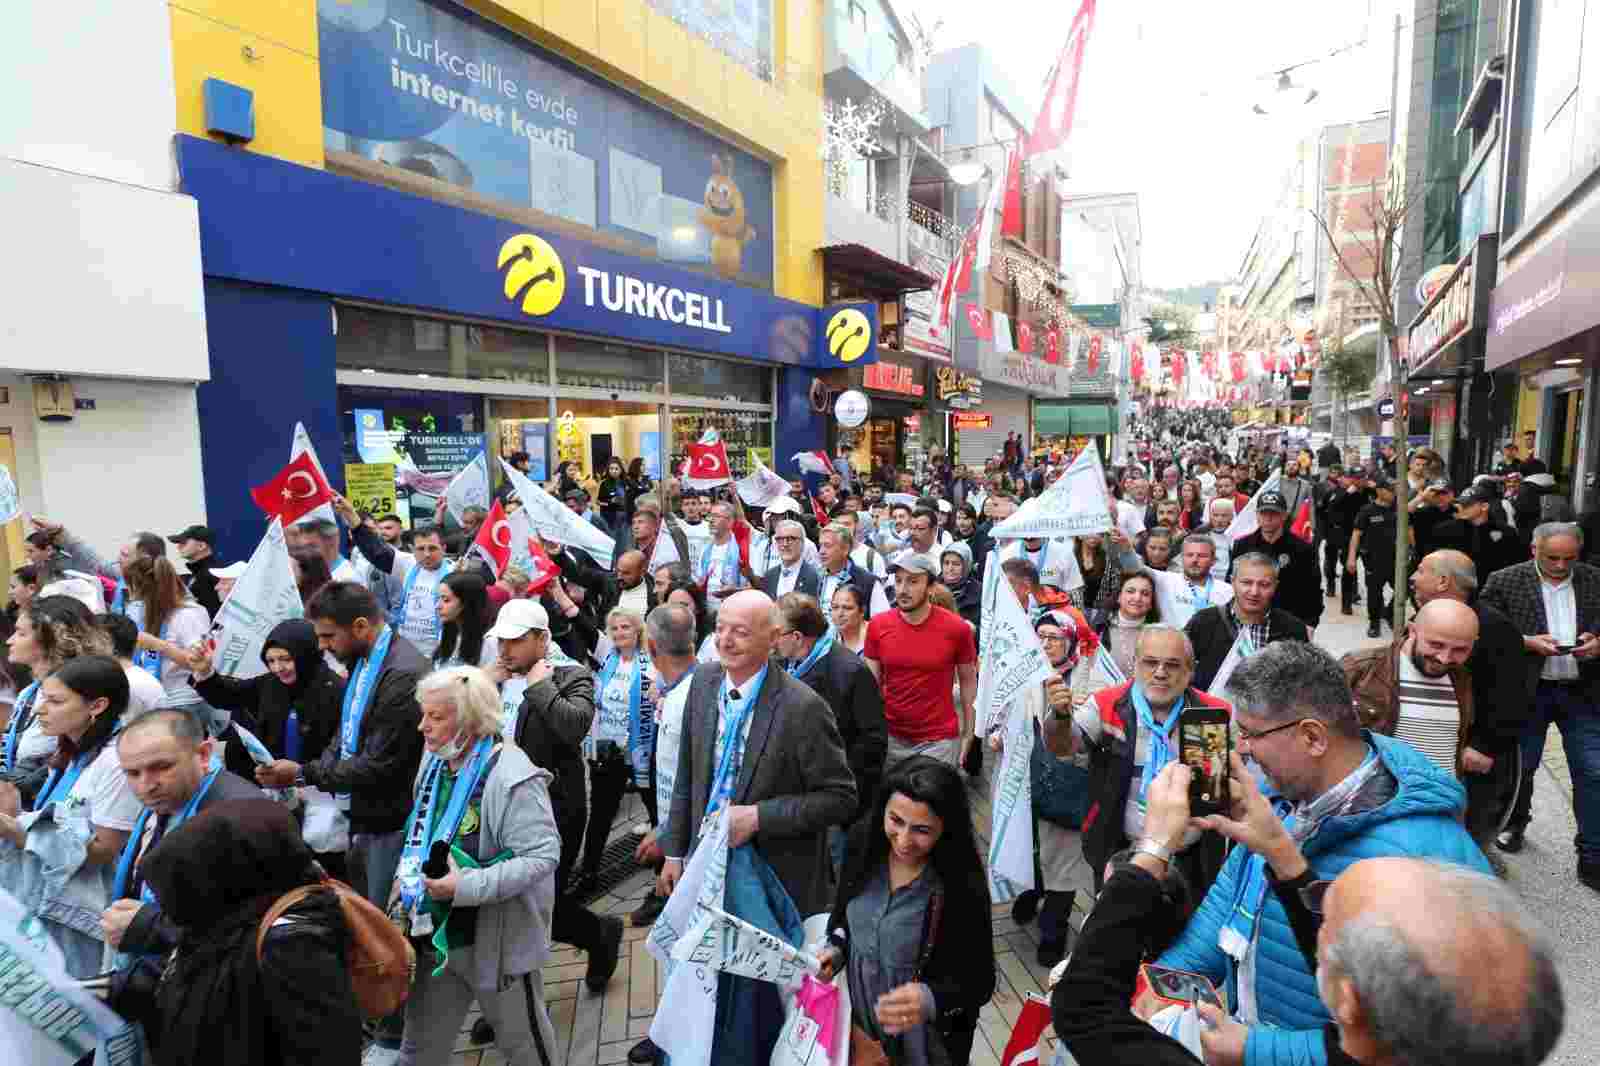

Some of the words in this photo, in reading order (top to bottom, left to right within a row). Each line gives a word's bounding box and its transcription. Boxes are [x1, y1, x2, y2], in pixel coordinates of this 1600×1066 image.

[389, 16, 518, 99] Turkcell'le
[526, 88, 577, 125] evde
[391, 57, 504, 127] internet
[577, 265, 732, 333] TURKCELL
